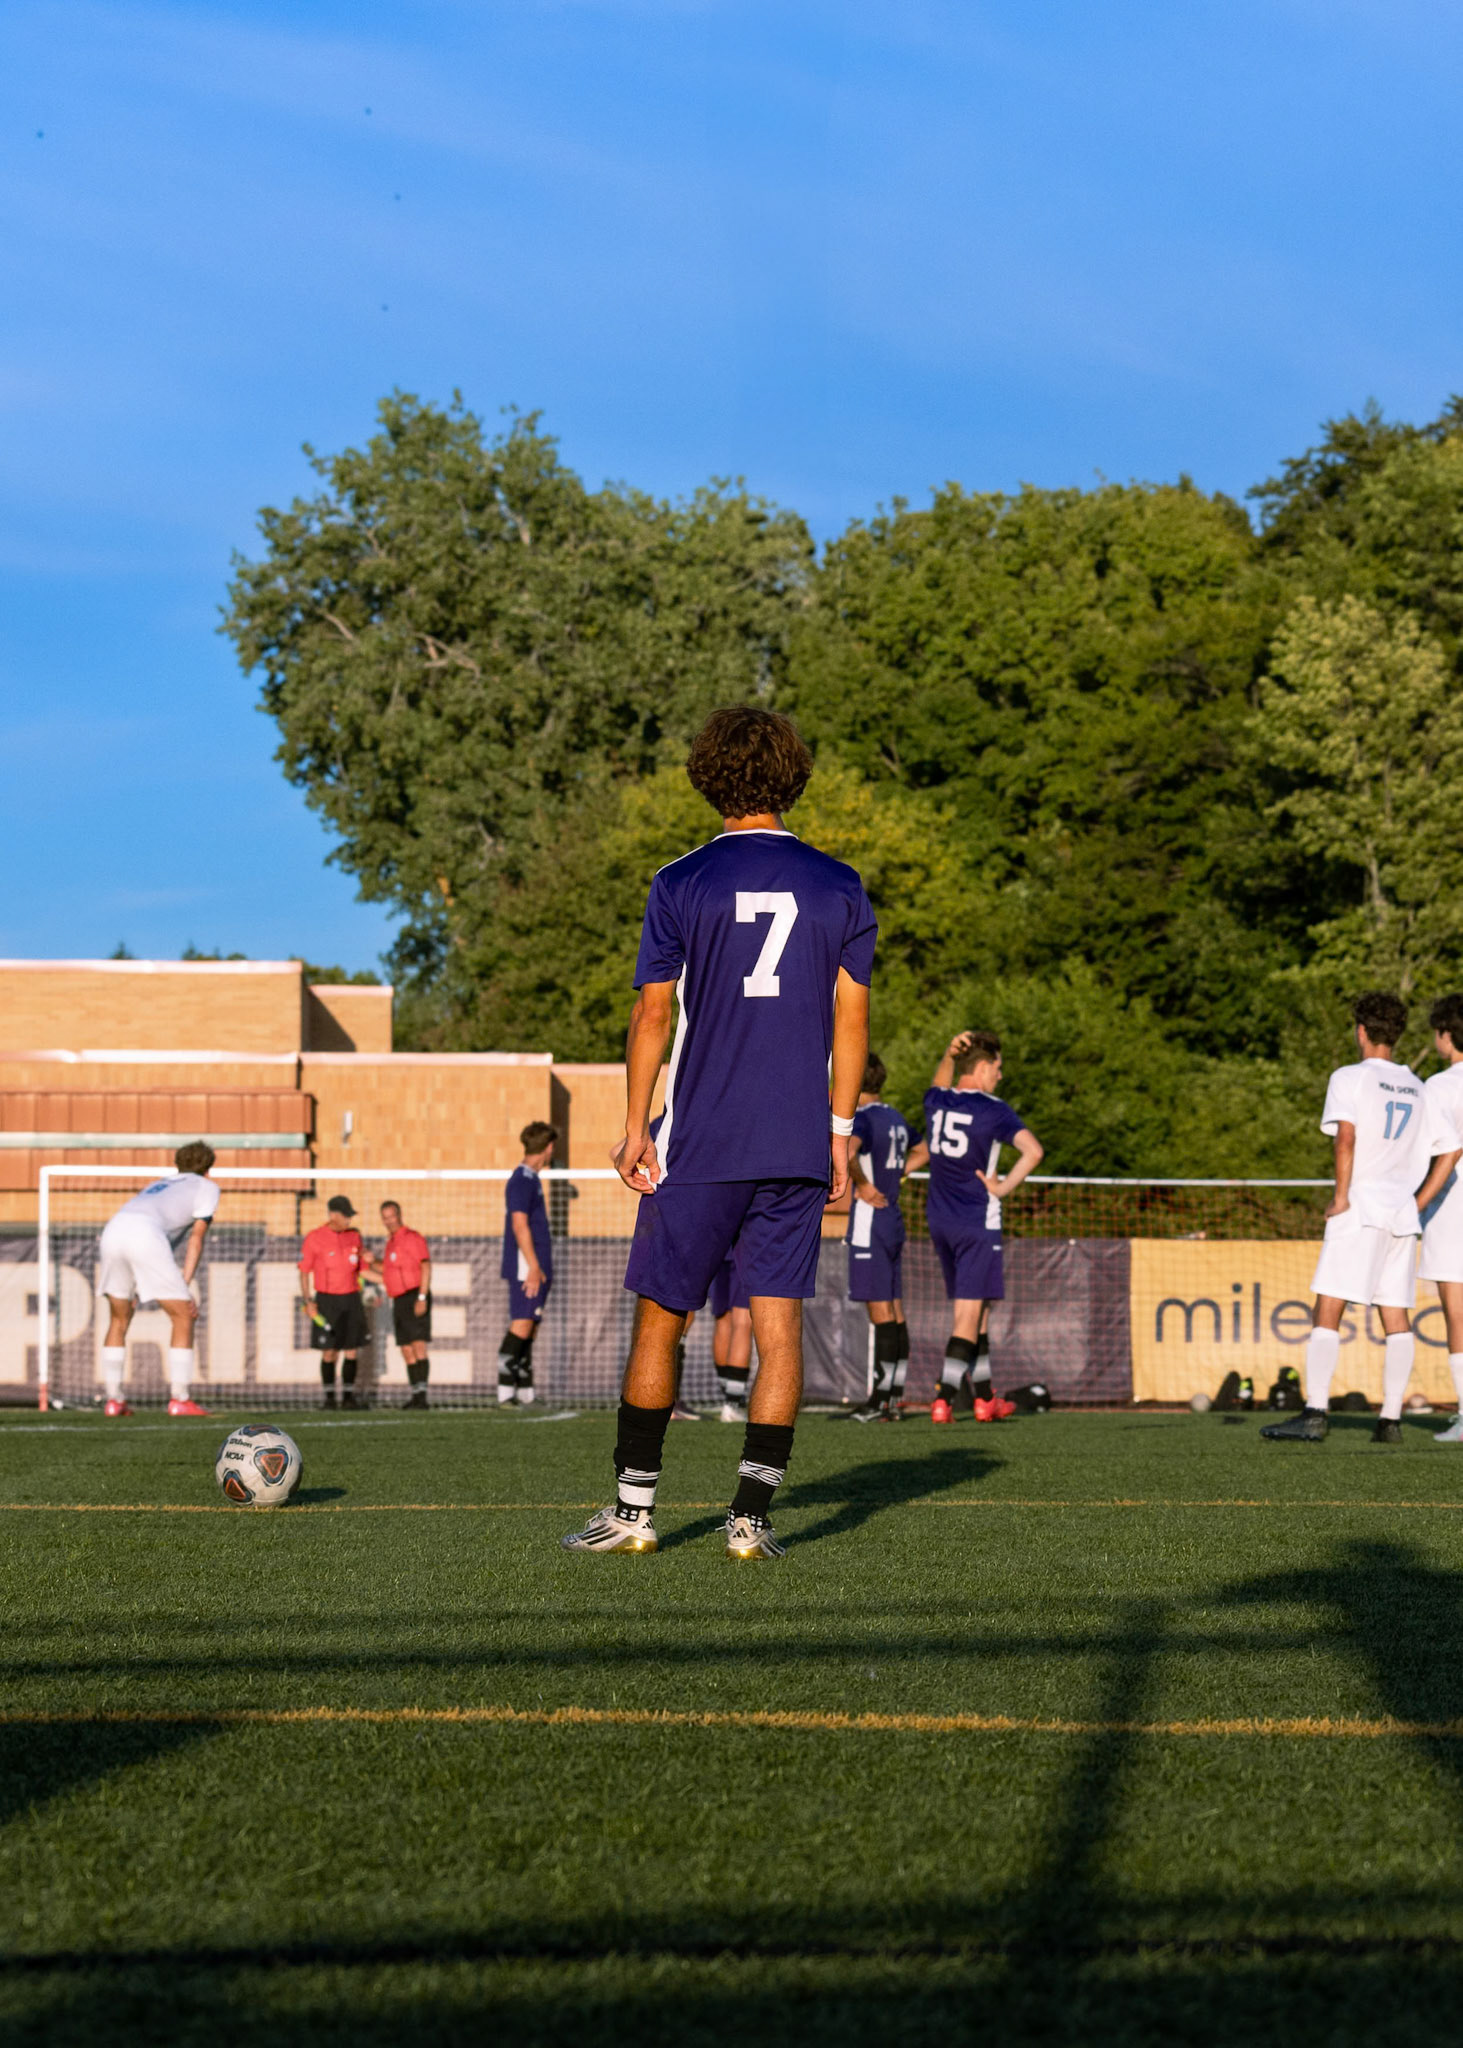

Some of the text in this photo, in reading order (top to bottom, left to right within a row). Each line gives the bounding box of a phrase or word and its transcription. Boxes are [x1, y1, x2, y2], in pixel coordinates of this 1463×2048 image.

[736, 892, 799, 997] 7
[930, 1109, 973, 1158] 15
[1384, 1101, 1412, 1140] 17
[225, 1451, 245, 1461] NCAA
